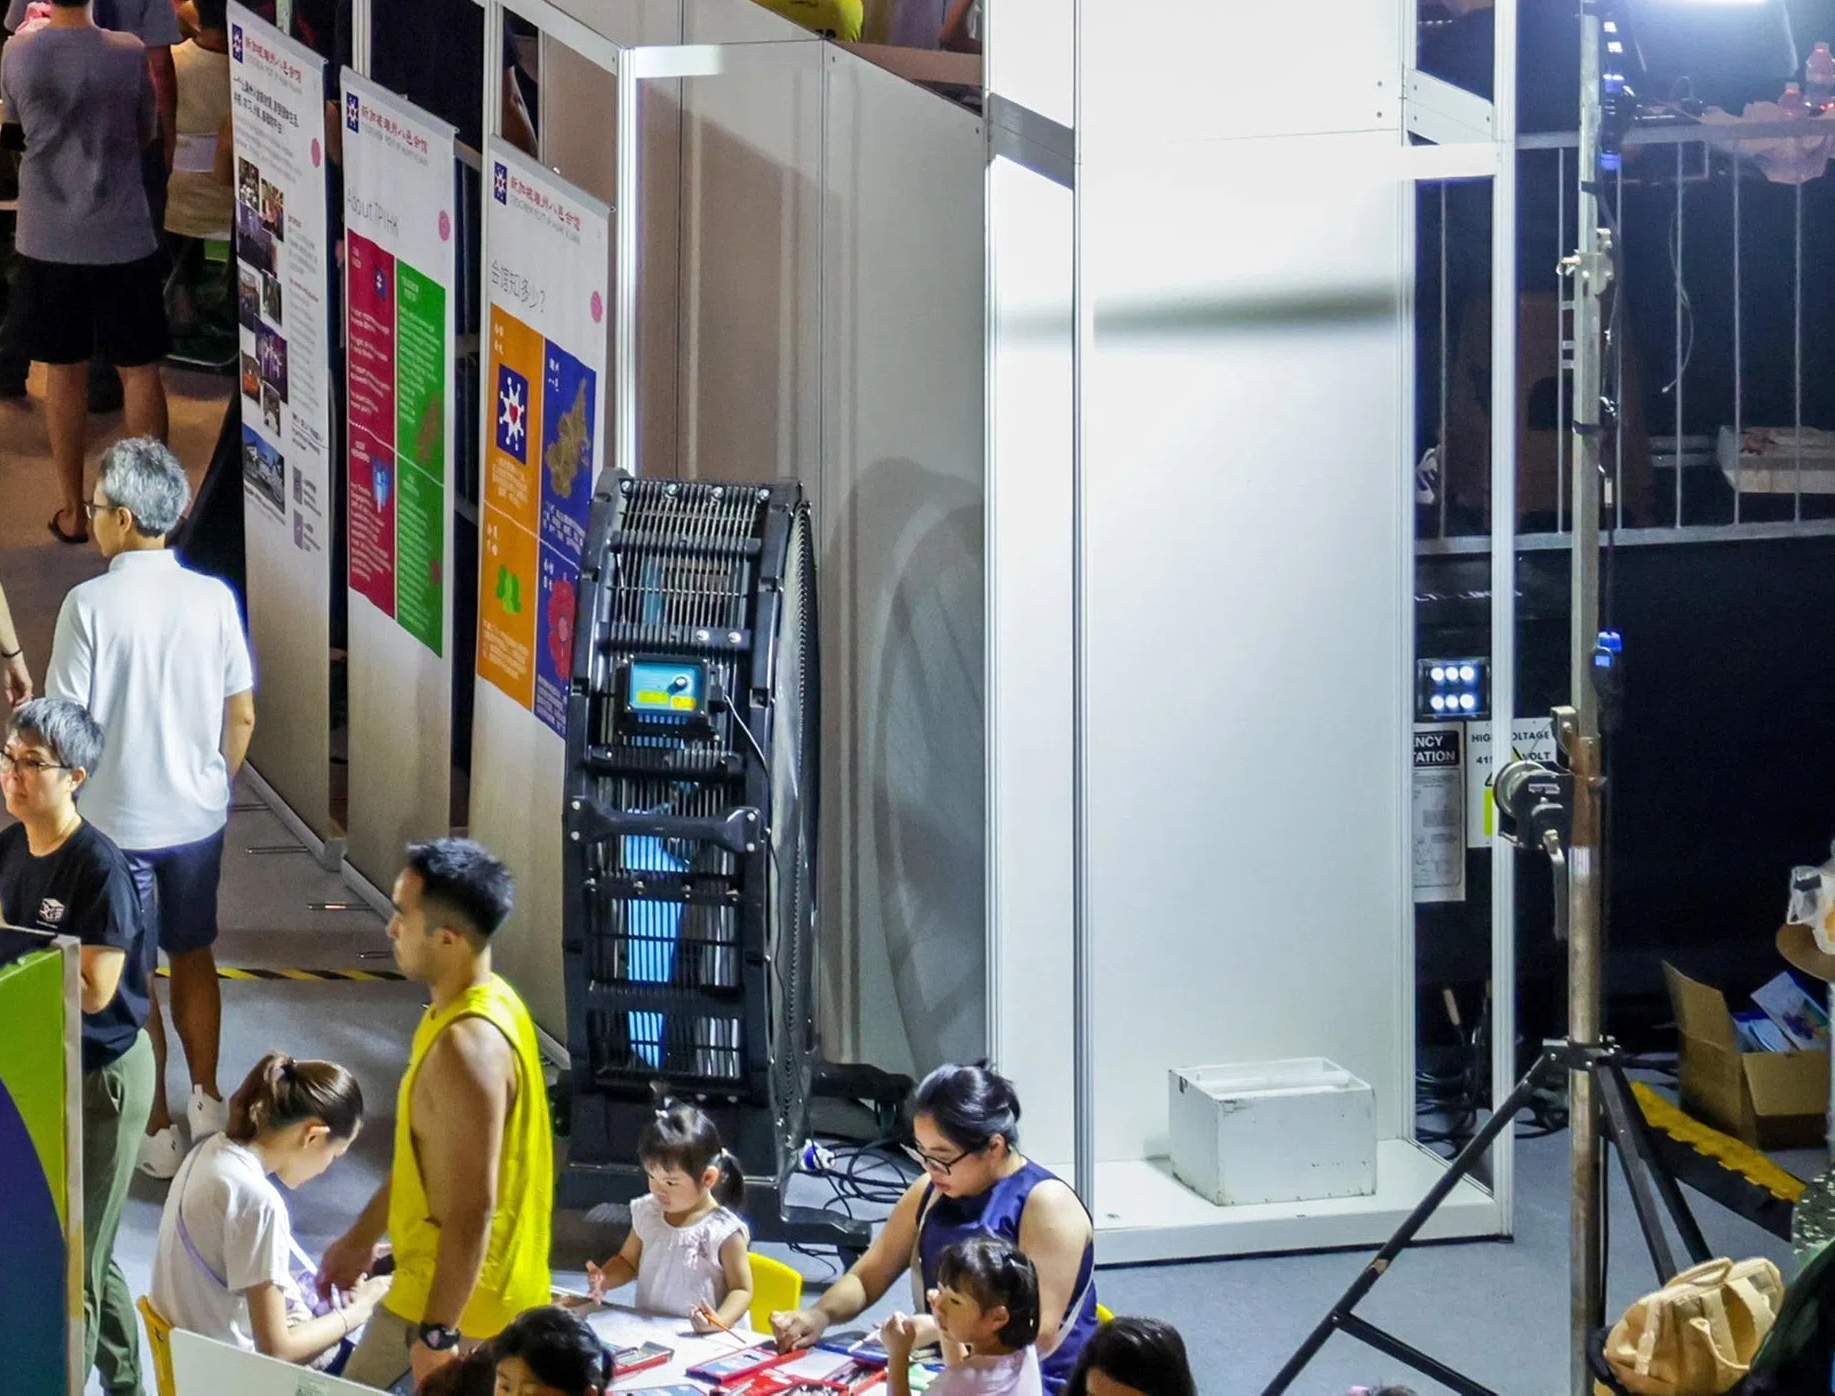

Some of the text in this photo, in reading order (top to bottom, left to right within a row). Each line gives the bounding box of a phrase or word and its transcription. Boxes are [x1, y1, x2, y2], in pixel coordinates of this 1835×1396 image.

[1414, 735, 1444, 748] NCY
[1471, 730, 1550, 743] HIG OLTAGE
